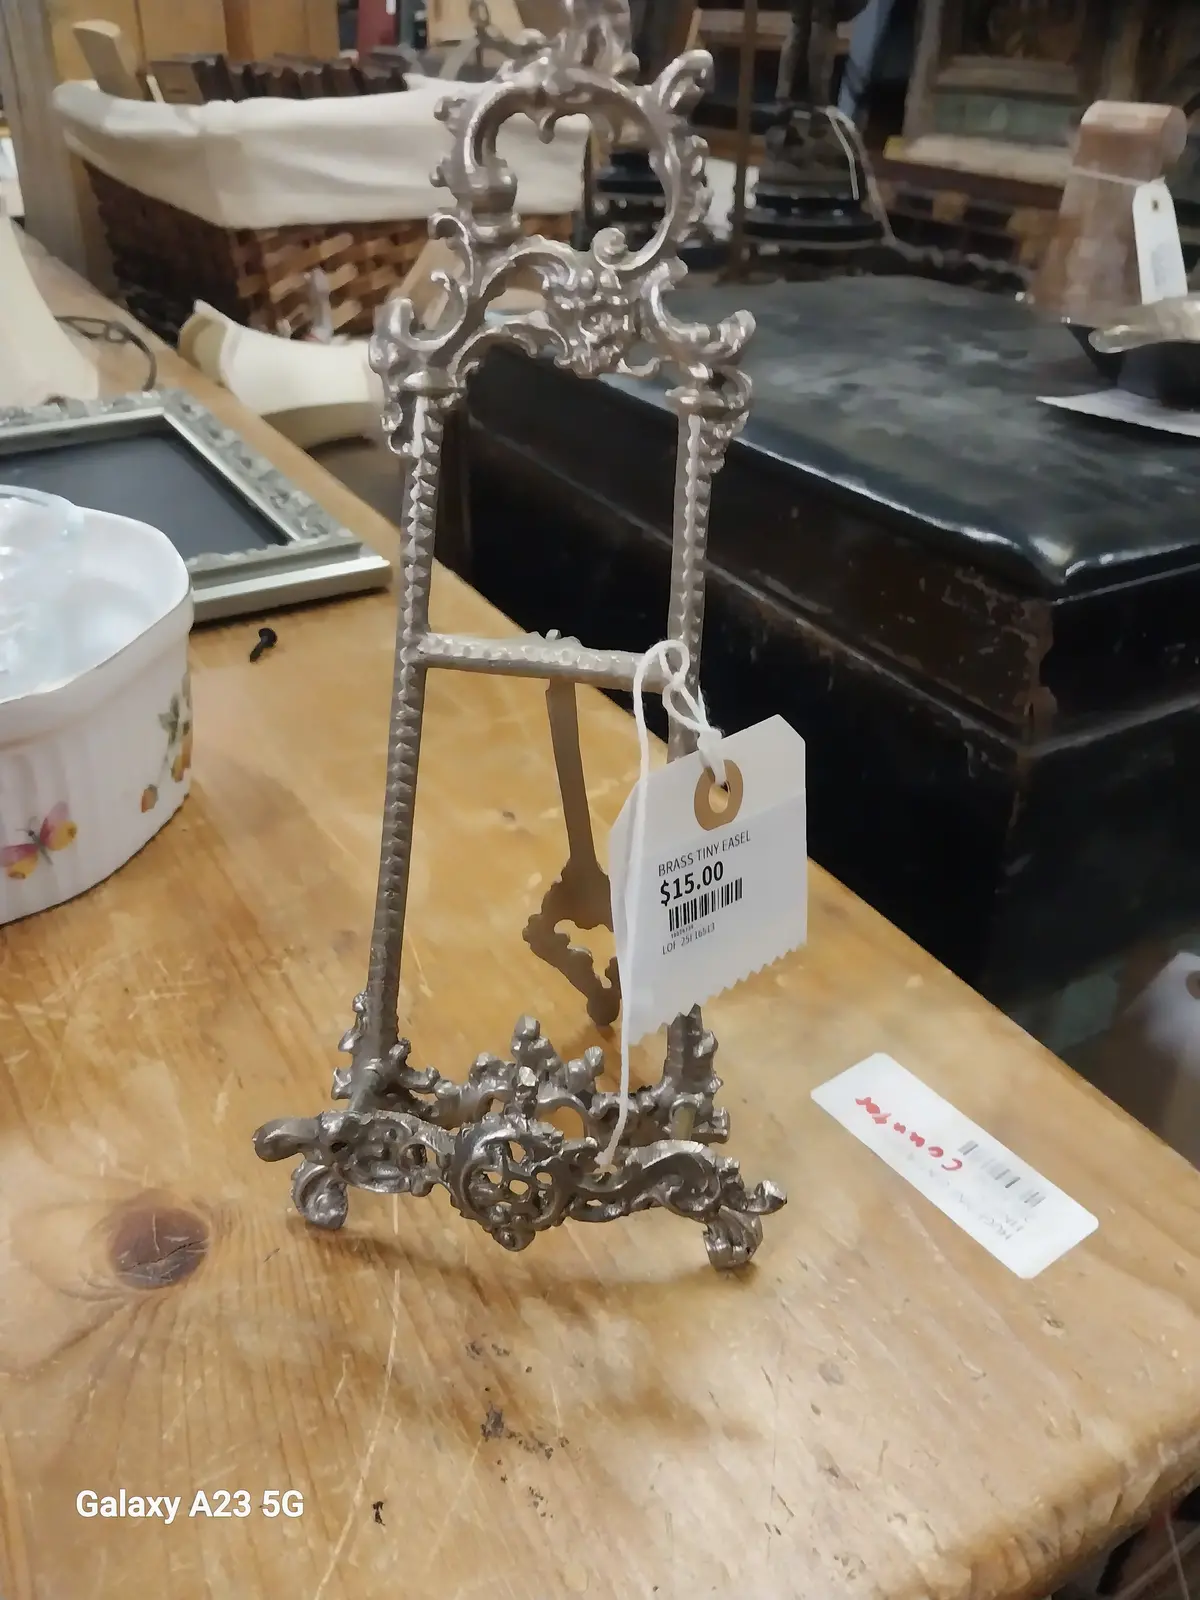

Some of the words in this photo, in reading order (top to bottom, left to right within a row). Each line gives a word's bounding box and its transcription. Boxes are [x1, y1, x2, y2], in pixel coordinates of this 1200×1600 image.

[658, 852, 694, 877] BRASS
[696, 841, 721, 862] TINY
[722, 830, 751, 852] EASEL
[660, 860, 724, 907] $15.00
